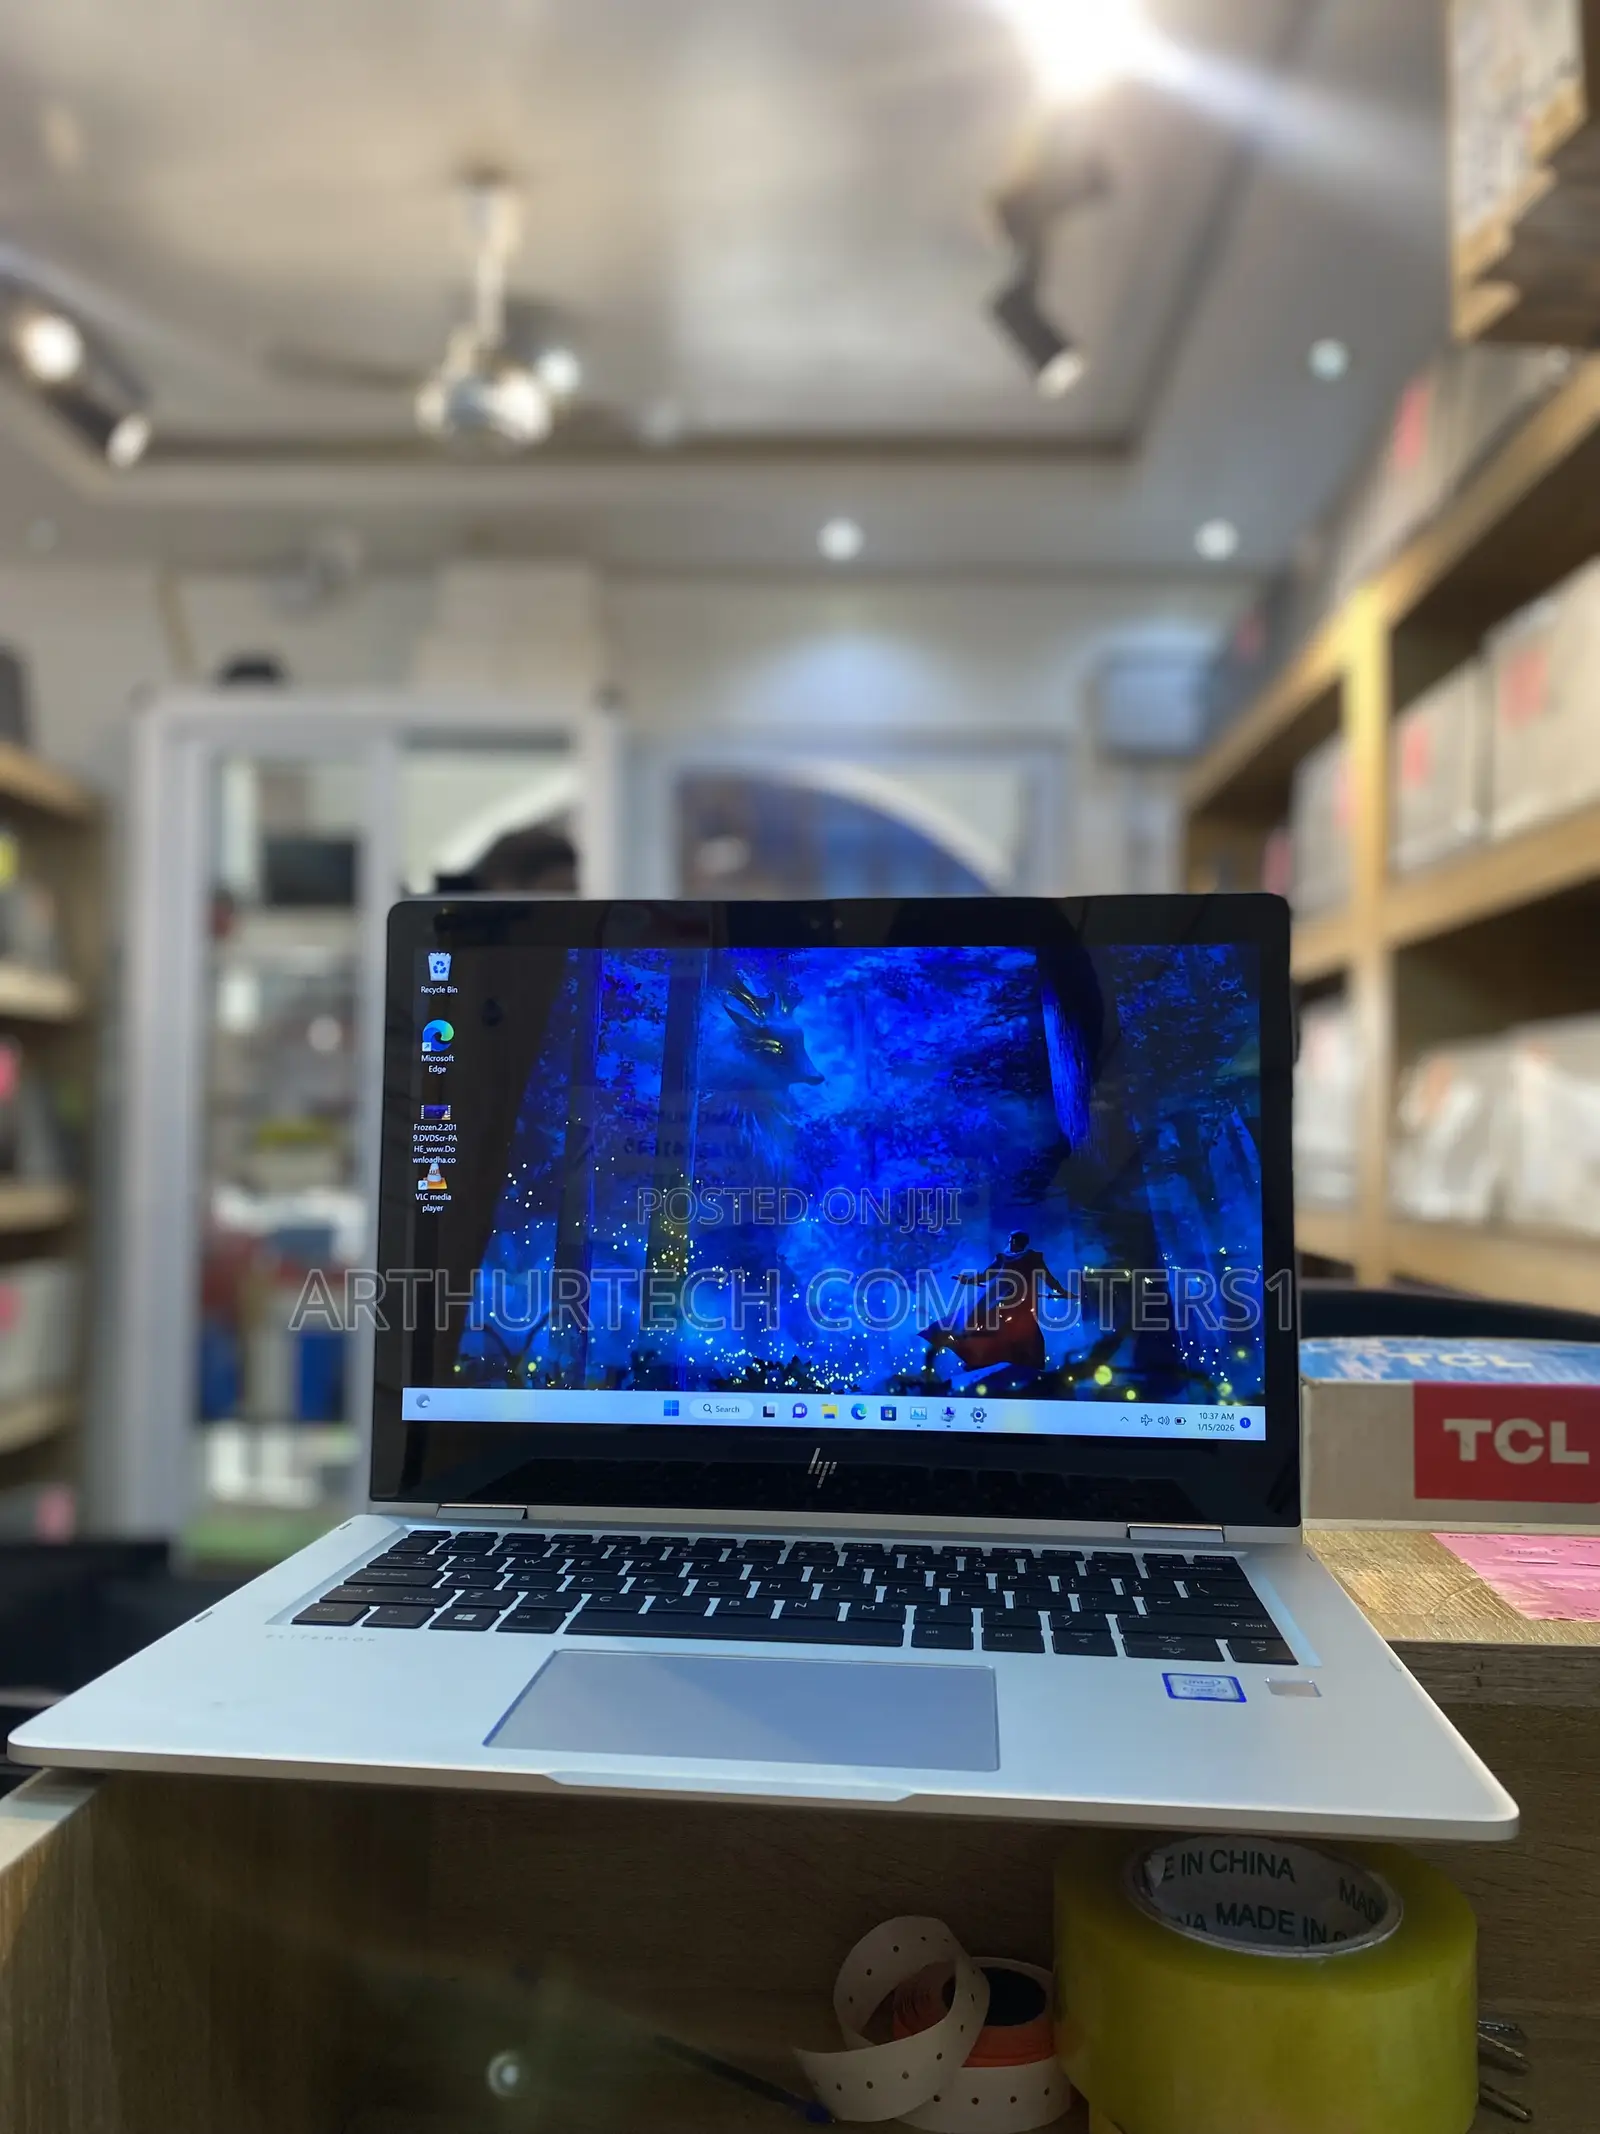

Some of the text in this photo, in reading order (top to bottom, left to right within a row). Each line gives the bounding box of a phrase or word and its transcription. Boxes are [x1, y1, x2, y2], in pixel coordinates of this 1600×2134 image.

[420, 986, 458, 995] Recycle Bin
[420, 1054, 454, 1063] Microsoft
[428, 1065, 447, 1074] Edge
[413, 1123, 457, 1132] Frozen.2.201
[412, 1134, 458, 1142] 9.DVDScr-PA
[415, 1193, 452, 1201] VLC media
[422, 1204, 444, 1213] player
[1385, 1352, 1533, 1368] TCL
[715, 1405, 740, 1414] Search
[1199, 1412, 1219, 1420] 10:37
[1198, 1423, 1235, 1432] 1/15/2026
[1443, 1417, 1590, 1465] TCL
[1181, 1851, 1203, 1877] IN
[1210, 1849, 1297, 1884] CHINA
[1339, 1876, 1383, 1925] MAD
[1216, 1901, 1295, 1936] MADE
[1303, 1914, 1328, 1948] IN
